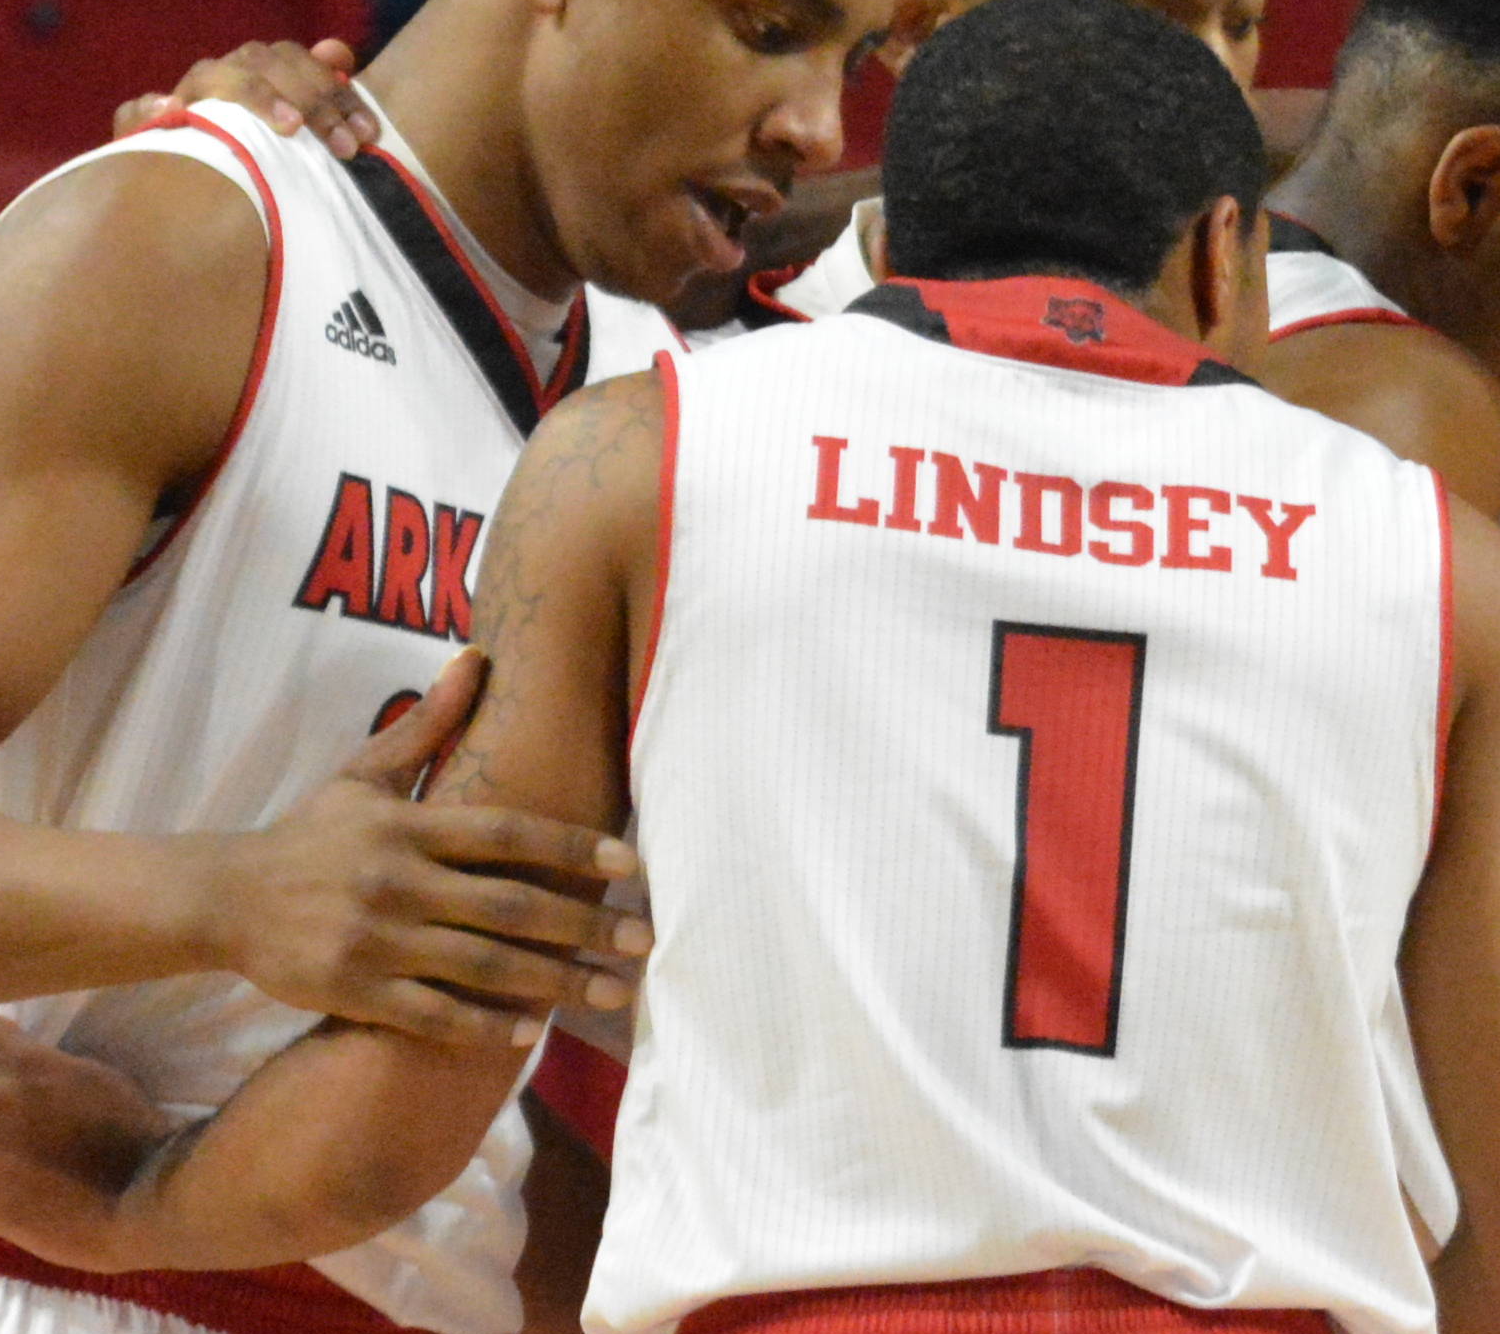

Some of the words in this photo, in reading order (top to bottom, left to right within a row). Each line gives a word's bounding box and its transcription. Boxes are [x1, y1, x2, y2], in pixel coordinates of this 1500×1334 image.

[325, 321, 397, 367] adidas
[806, 434, 1317, 581] LINDSEY
[986, 618, 1148, 1059] 1
